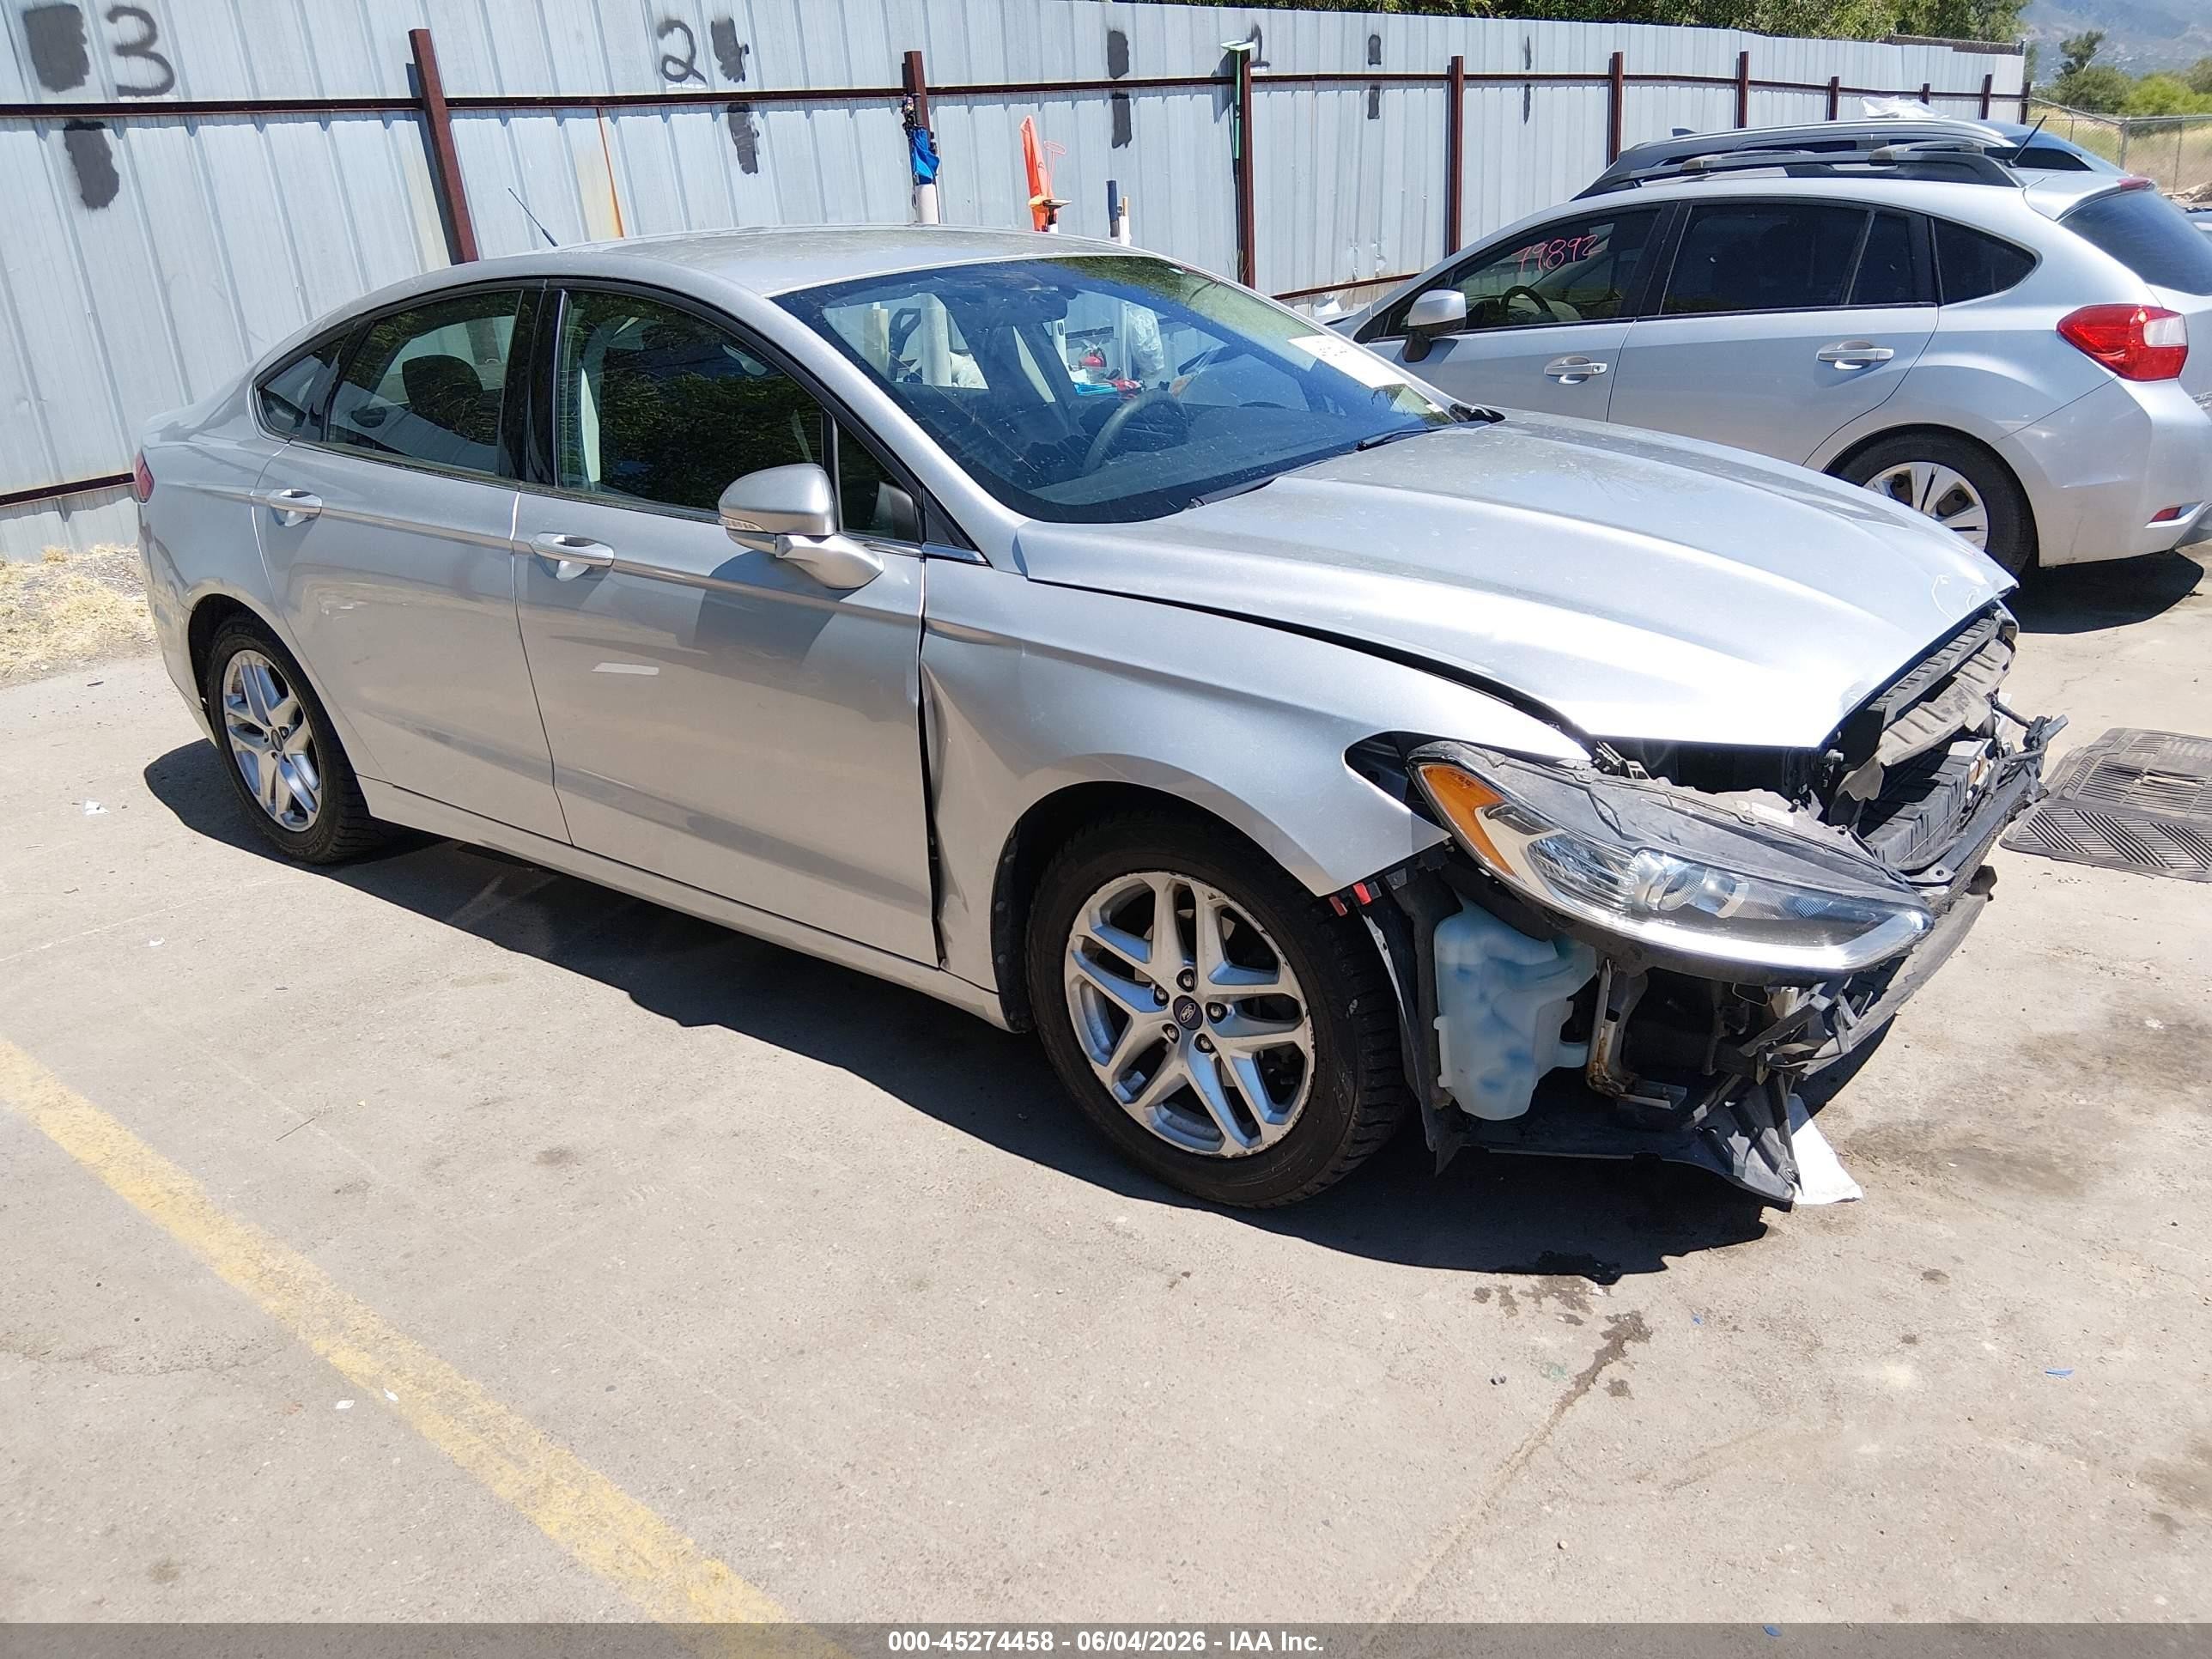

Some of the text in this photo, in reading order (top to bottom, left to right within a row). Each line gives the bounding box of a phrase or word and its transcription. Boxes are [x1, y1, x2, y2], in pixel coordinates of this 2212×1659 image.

[106, 5, 175, 97] 3
[657, 16, 708, 84] 2
[1511, 234, 1603, 274] 79892
